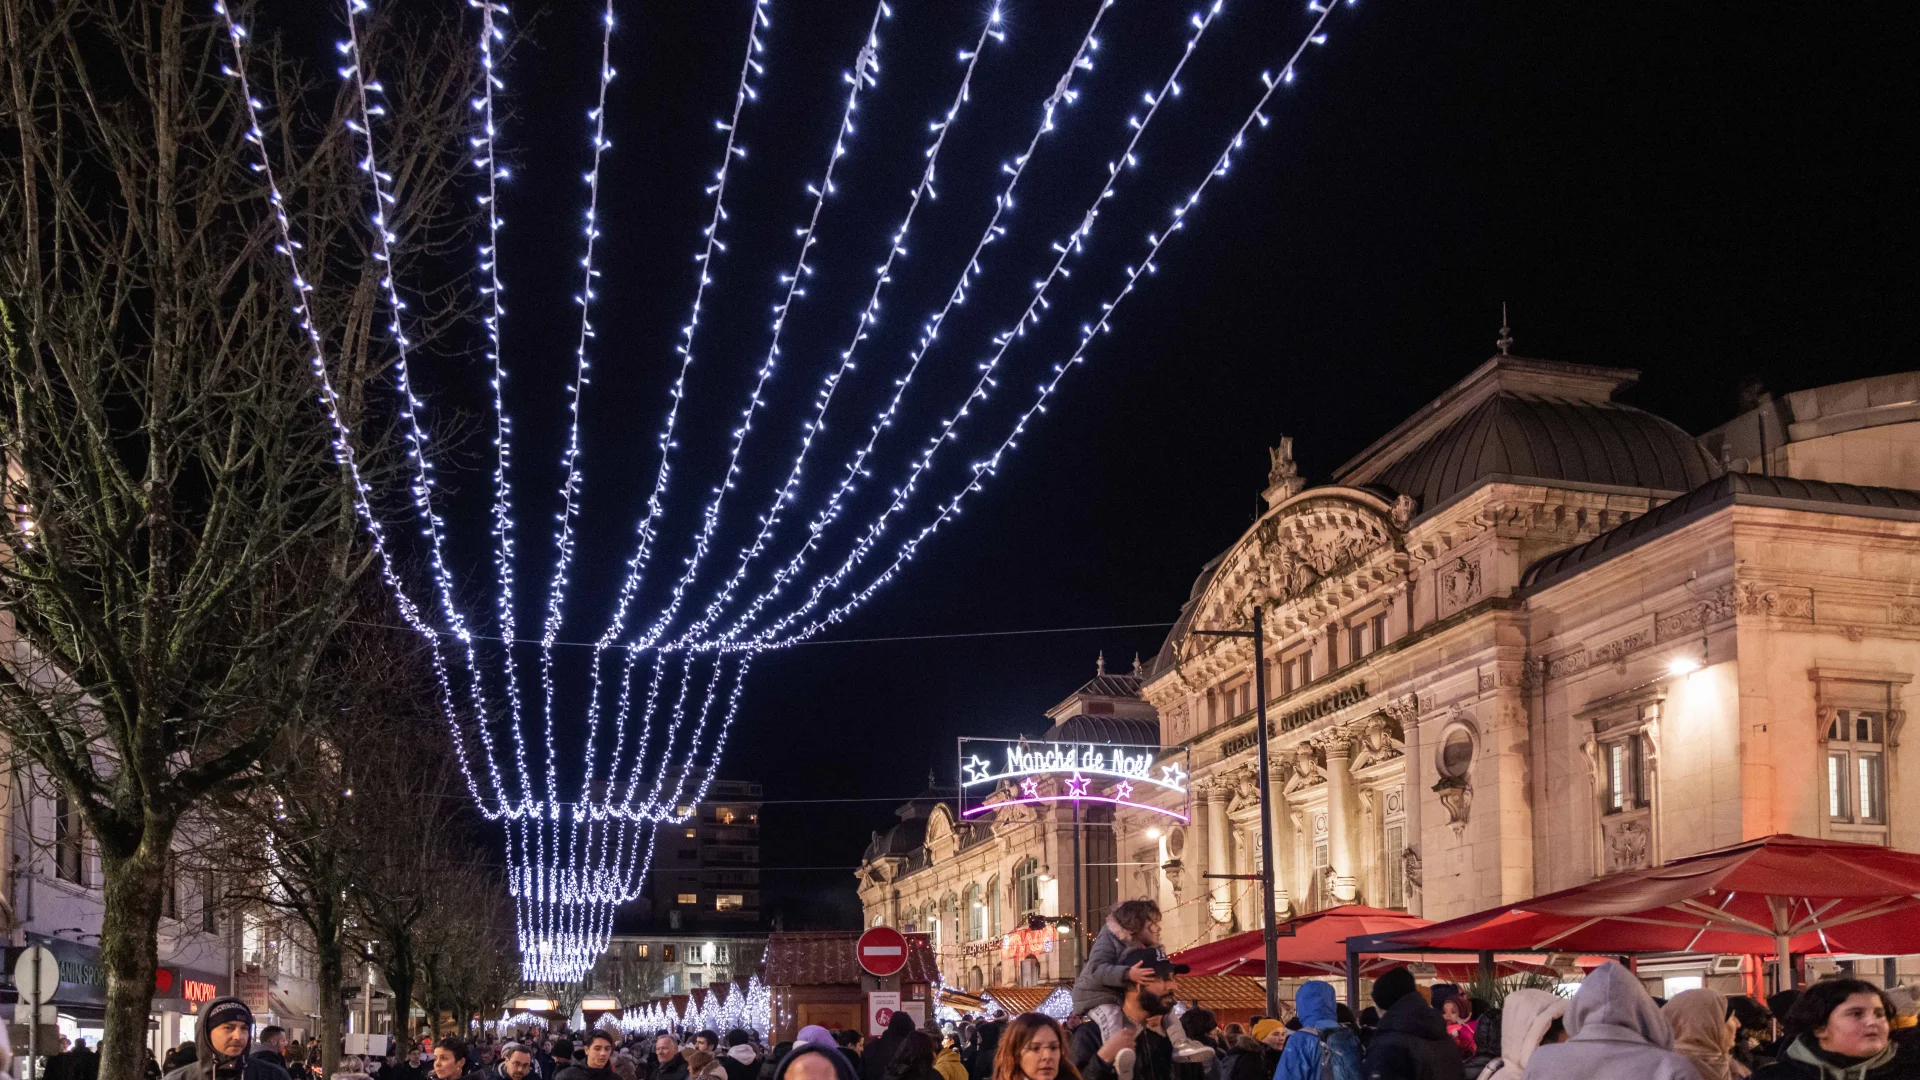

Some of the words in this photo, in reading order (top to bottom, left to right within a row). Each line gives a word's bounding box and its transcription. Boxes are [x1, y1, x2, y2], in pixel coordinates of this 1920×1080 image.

[1220, 719, 1276, 757] THEATE
[1280, 679, 1369, 732] MUNICIPAL
[1083, 743, 1104, 771] de
[1112, 748, 1153, 778] Noël
[60, 961, 82, 984] ANIN
[83, 965, 105, 987] SPOR
[184, 979, 217, 1002] MONOPRIX
